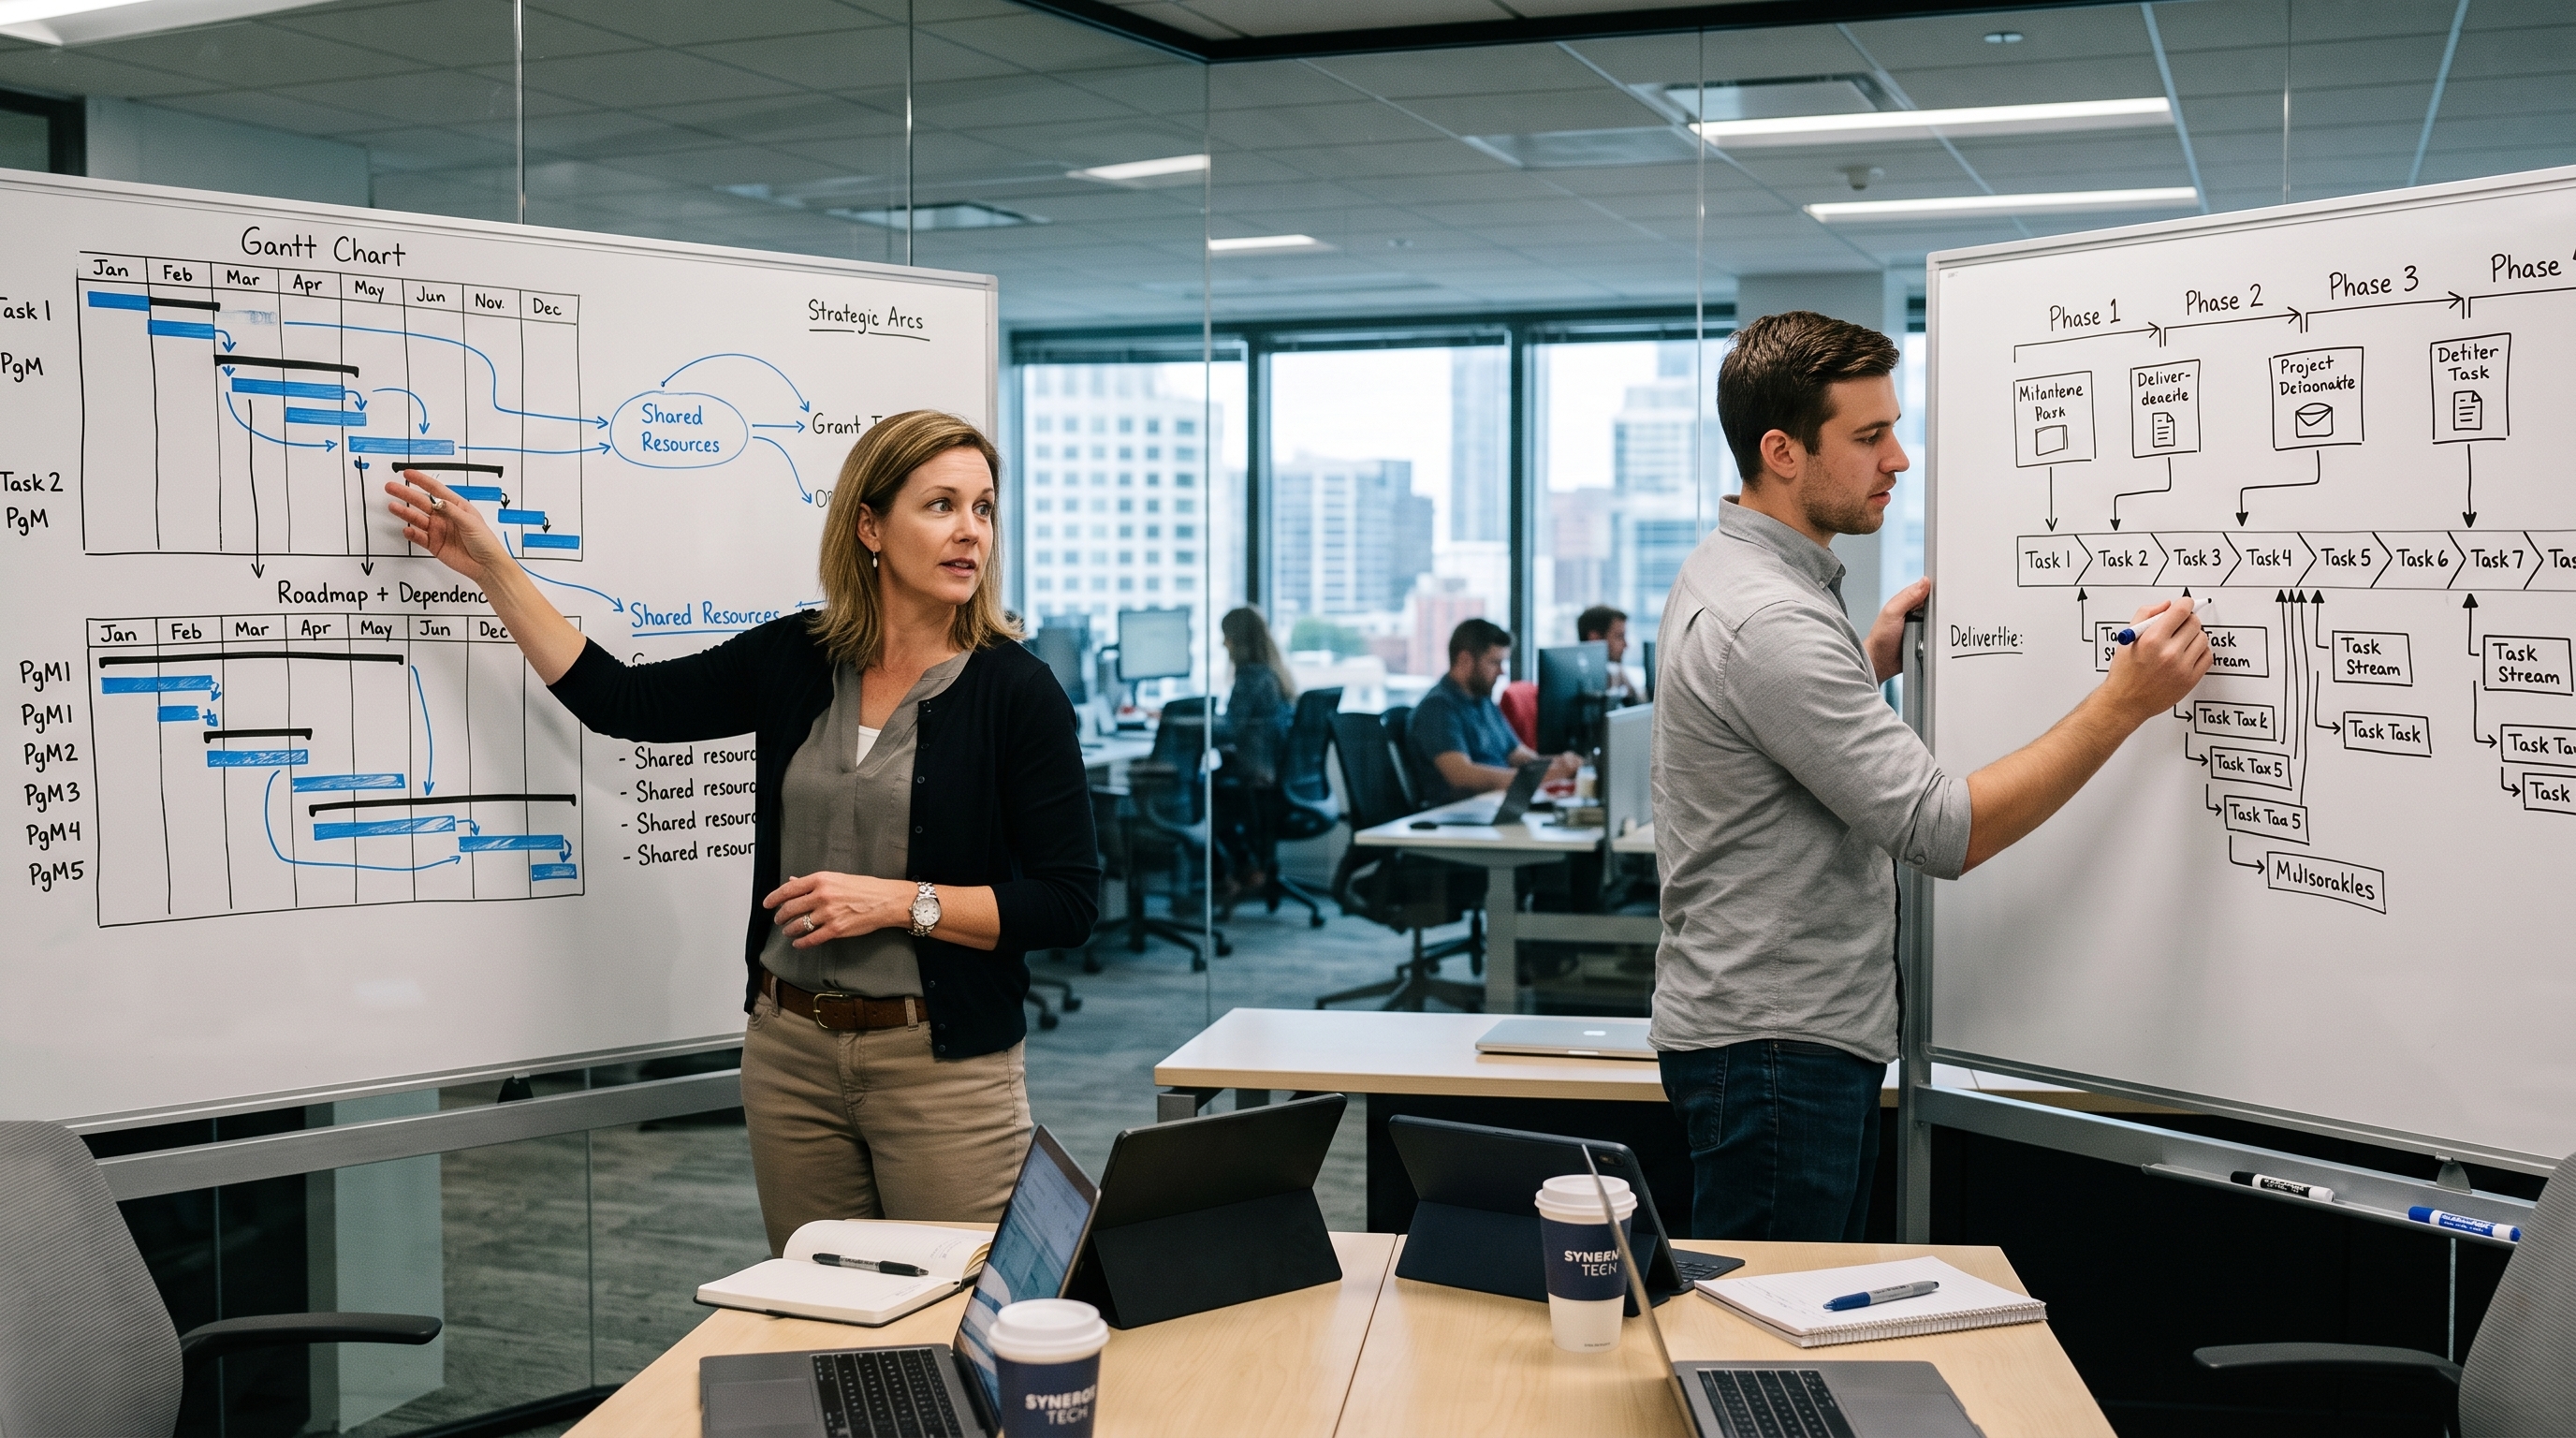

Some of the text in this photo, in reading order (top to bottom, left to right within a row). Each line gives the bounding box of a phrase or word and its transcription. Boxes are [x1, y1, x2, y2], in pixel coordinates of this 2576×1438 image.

[242, 227, 408, 267] Gantt Chart
[94, 259, 128, 277] Jan
[163, 265, 193, 282] Feb
[227, 270, 259, 286] Mar
[2491, 254, 2561, 283] Phase
[293, 273, 323, 295] Apr
[355, 280, 385, 302] May
[2329, 264, 2420, 300] Phase 3
[417, 286, 446, 302] Jun
[476, 293, 505, 309] Nov.
[2186, 283, 2264, 315] Phase 2
[0, 297, 37, 320] ask
[534, 298, 562, 315] Dec
[809, 299, 923, 334] Strategic Arcs
[2050, 298, 2121, 331] Phase 1
[2437, 344, 2498, 362] Detiter
[0, 352, 43, 383] PgM
[2281, 355, 2334, 379] Project
[2448, 365, 2490, 381] Task
[2138, 372, 2190, 388] Deliver-
[642, 403, 703, 425] Shared
[812, 413, 861, 434] Grant
[642, 432, 719, 452] Resources
[0, 471, 65, 492] Task 2
[7, 506, 49, 536] PgM
[2025, 550, 2071, 569] Task 1
[2098, 549, 2149, 567] Task 2
[2174, 548, 2222, 567] Task 3
[2246, 549, 2292, 567] Task 4
[2320, 548, 2372, 567] Task 5
[2396, 549, 2450, 568] Task 6
[2470, 549, 2525, 569] Task 7
[2548, 549, 2576, 569] Tas
[278, 580, 489, 610] Roadmap + Dependenc
[631, 601, 780, 627] Shared Resources
[100, 624, 137, 642] Jan
[171, 623, 202, 639] Feb
[236, 622, 269, 637] Mar
[301, 620, 331, 636] Apr
[361, 620, 393, 642] May
[419, 620, 450, 636] Jun
[480, 621, 507, 638] Dec
[2204, 630, 2238, 648] Task
[2340, 638, 2381, 654] Task
[2212, 653, 2250, 668] tream
[2492, 643, 2538, 662] Task
[2347, 659, 2400, 676] Stream
[2498, 666, 2560, 684] Stream
[2199, 708, 2231, 726] Task
[2233, 711, 2257, 726] Tax
[2349, 720, 2421, 743] Task Task
[2508, 733, 2576, 755] Task Ta
[24, 742, 78, 773] PgM2
[635, 745, 694, 770] Shared
[704, 749, 755, 764] resourc
[2215, 754, 2283, 778] Task Tax 5
[24, 782, 80, 813] PgM3
[637, 778, 694, 802] Shared
[704, 781, 755, 796] resourc
[2529, 781, 2571, 803] Task
[637, 810, 696, 834] Shared
[705, 812, 755, 827] resourc
[2229, 803, 2261, 823] Task
[2291, 812, 2302, 830] 5
[26, 821, 80, 851] PgM4
[637, 841, 698, 866] Shared
[707, 843, 754, 858] resour
[29, 860, 84, 892] PgM5
